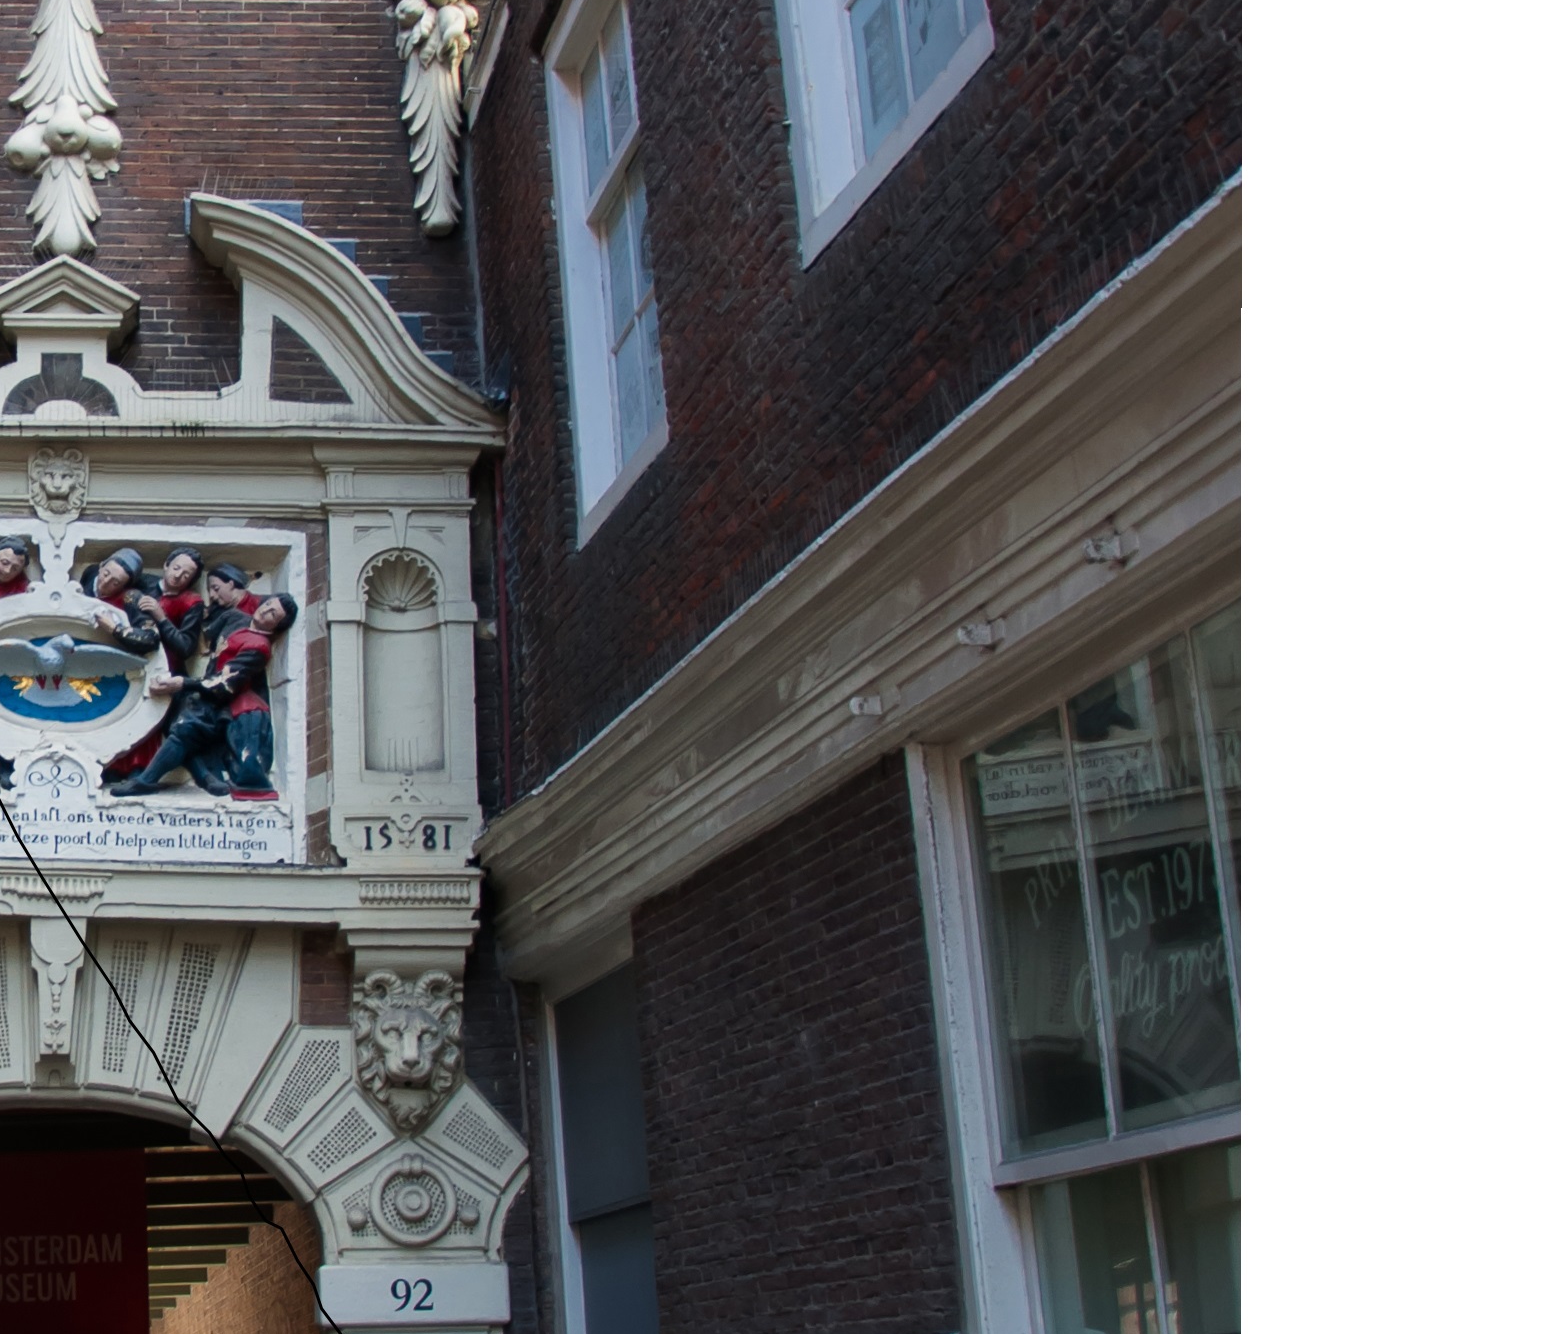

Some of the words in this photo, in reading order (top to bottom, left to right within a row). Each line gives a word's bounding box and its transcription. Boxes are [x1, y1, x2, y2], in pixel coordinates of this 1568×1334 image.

[67, 812, 94, 823] ons
[99, 810, 155, 825] tweede
[158, 812, 213, 828] Vaders
[217, 813, 277, 836] klagen
[12, 825, 49, 844] deze
[95, 830, 111, 846] of
[114, 831, 147, 856] help
[150, 836, 175, 848] een
[178, 833, 214, 849] luttel
[217, 832, 268, 860] dragen
[390, 1278, 434, 1312] 92
